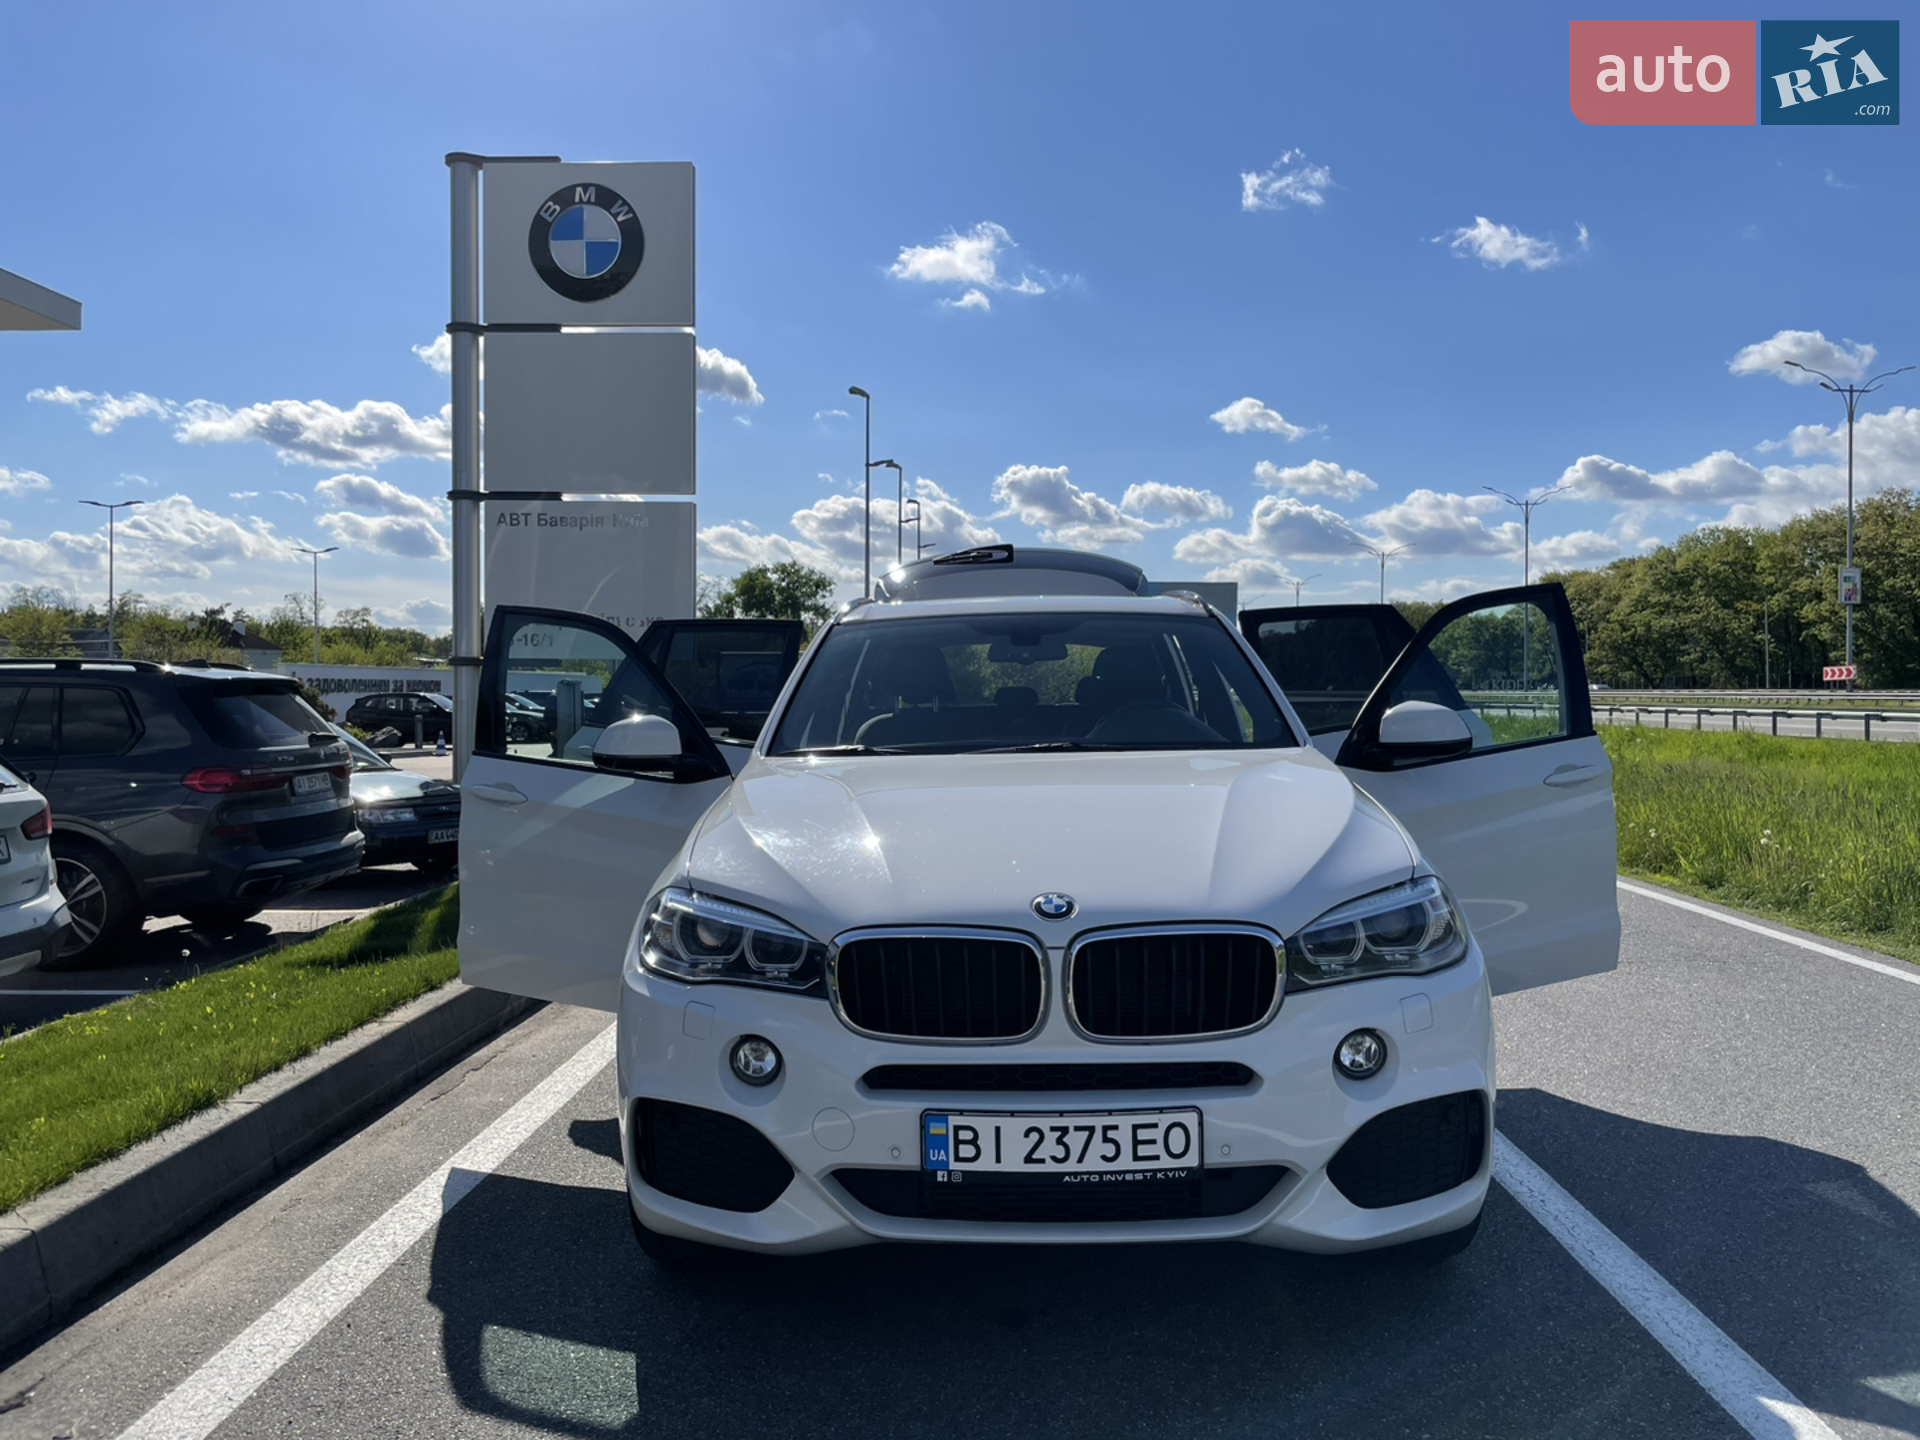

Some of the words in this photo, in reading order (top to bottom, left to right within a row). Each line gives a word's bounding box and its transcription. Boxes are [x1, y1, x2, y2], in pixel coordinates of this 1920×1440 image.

[539, 186, 633, 223] BMW
[496, 512, 532, 528] АВТ
[537, 512, 605, 531] Баварія
[930, 1149, 947, 1161] UA
[1063, 1174, 1100, 1183] AUTO
[1103, 1172, 1153, 1181] INVEST
[1156, 1171, 1188, 1179] KYIV
